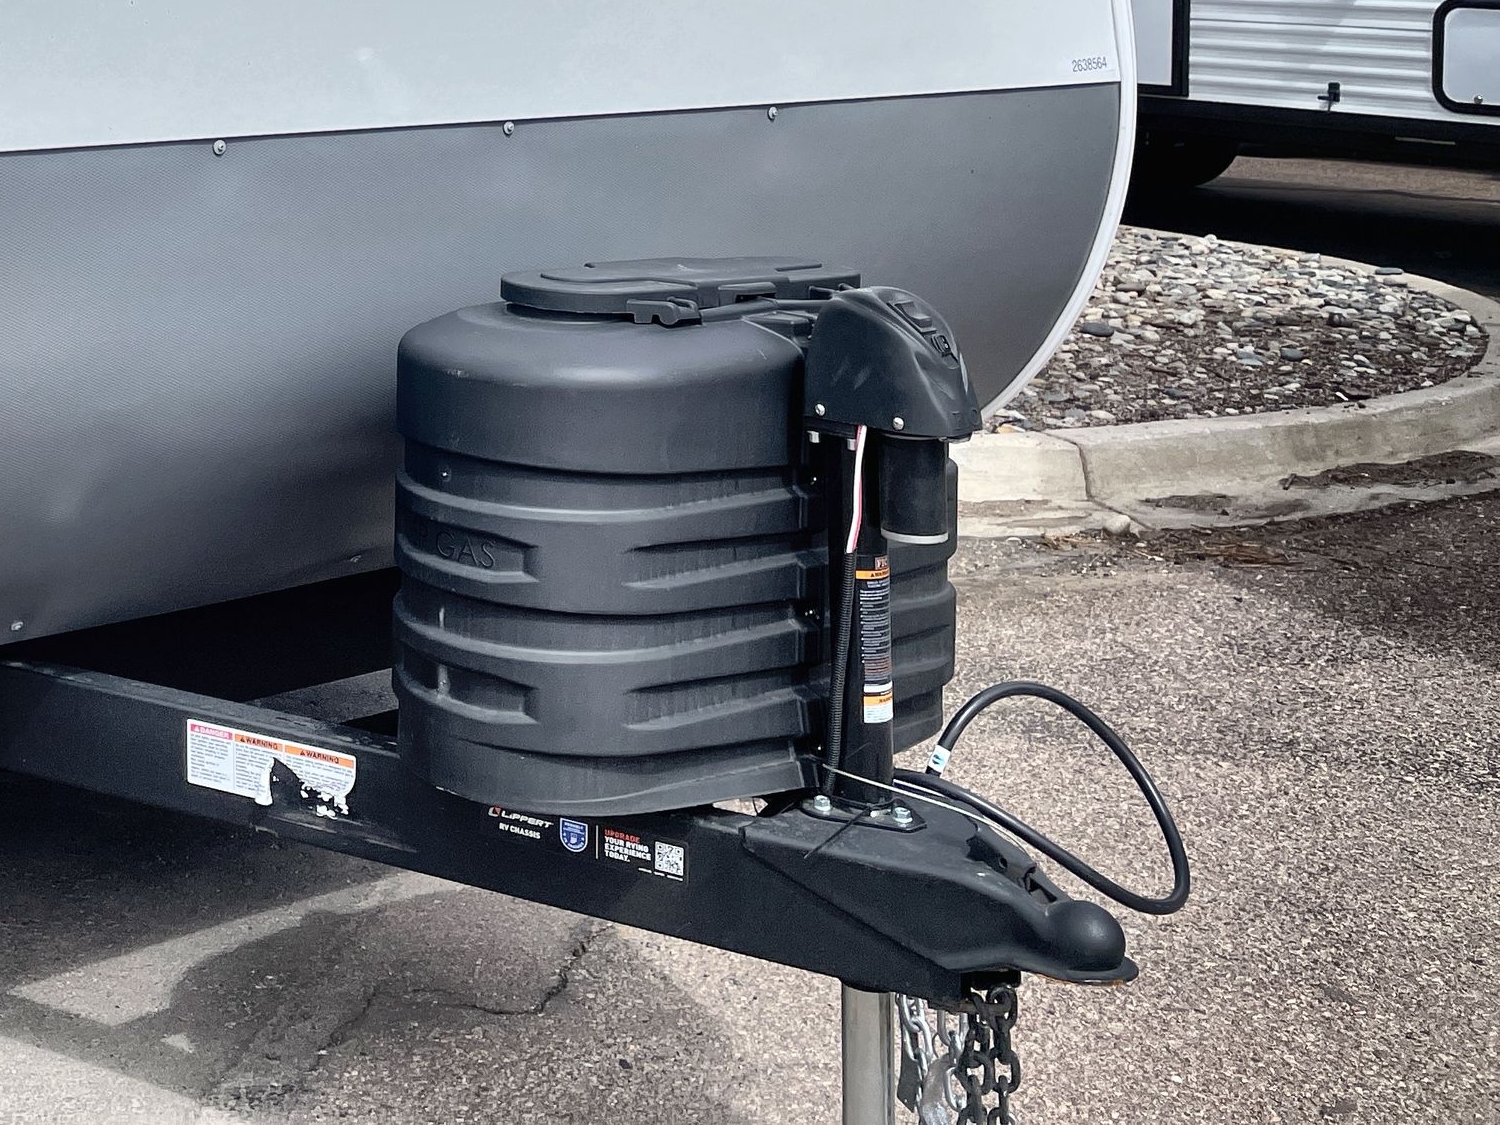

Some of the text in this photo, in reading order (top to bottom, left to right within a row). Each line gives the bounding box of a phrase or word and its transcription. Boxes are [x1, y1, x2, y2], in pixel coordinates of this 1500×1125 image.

[1071, 56, 1108, 73] 2638564
[435, 530, 496, 569] GAS
[199, 726, 231, 740] DANGER
[245, 736, 279, 750] WARNING
[305, 750, 340, 765] WARNING
[509, 825, 541, 840] CHASSIS
[604, 828, 641, 844] UPGRADE
[604, 836, 625, 847] YOUR
[604, 843, 652, 861] EXPERIENCE
[604, 849, 631, 863] TODAY.
